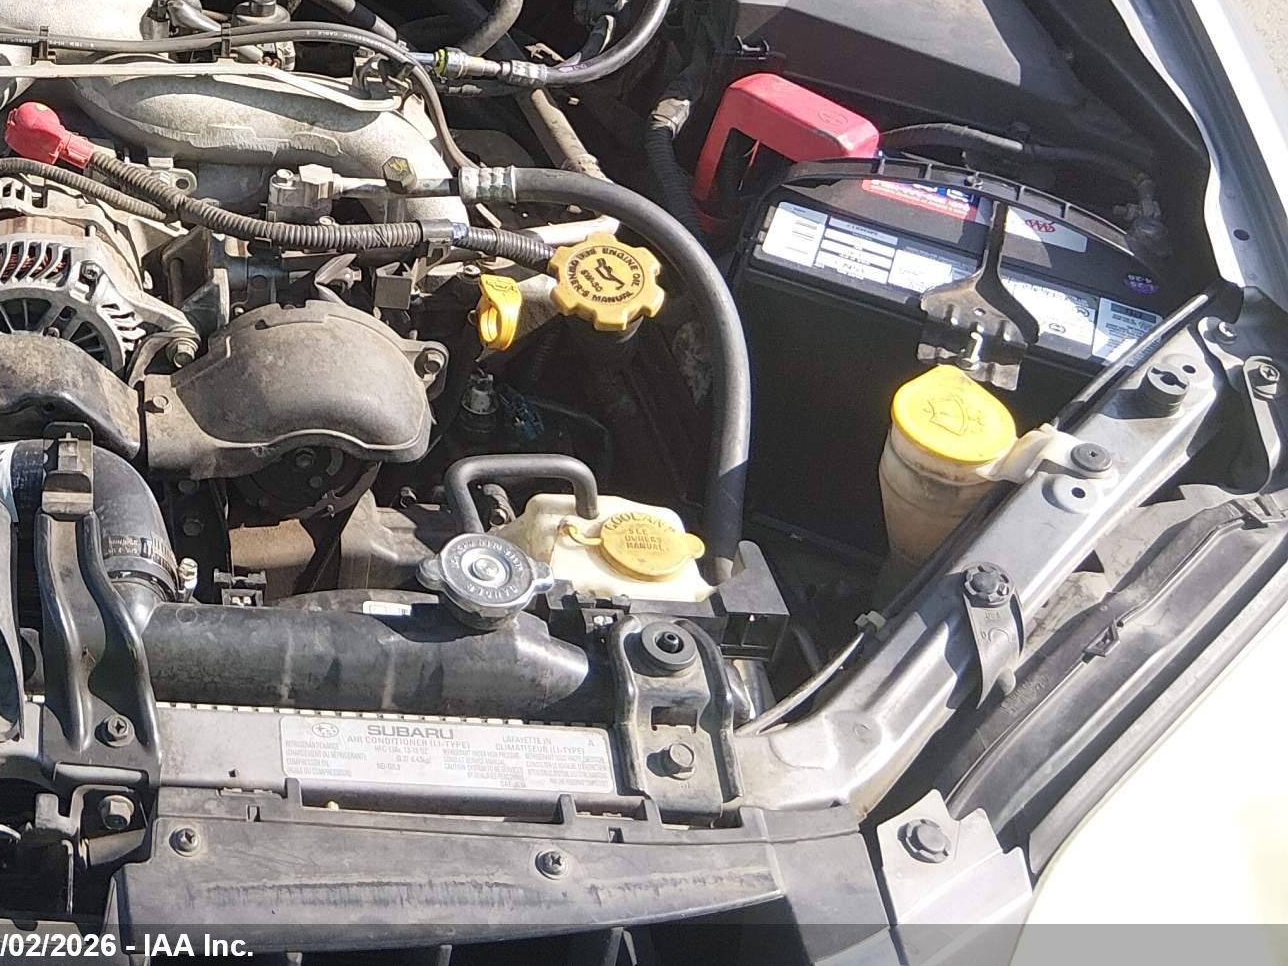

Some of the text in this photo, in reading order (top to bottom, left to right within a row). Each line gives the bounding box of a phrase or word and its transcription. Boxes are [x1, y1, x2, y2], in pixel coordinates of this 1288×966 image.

[602, 248, 640, 286] ENGINE OIL
[592, 291, 633, 302] MANUAL
[368, 724, 454, 740] SUBARU
[365, 736, 428, 746] CONDITIONER
[496, 743, 548, 753] CLIMATISEUR
